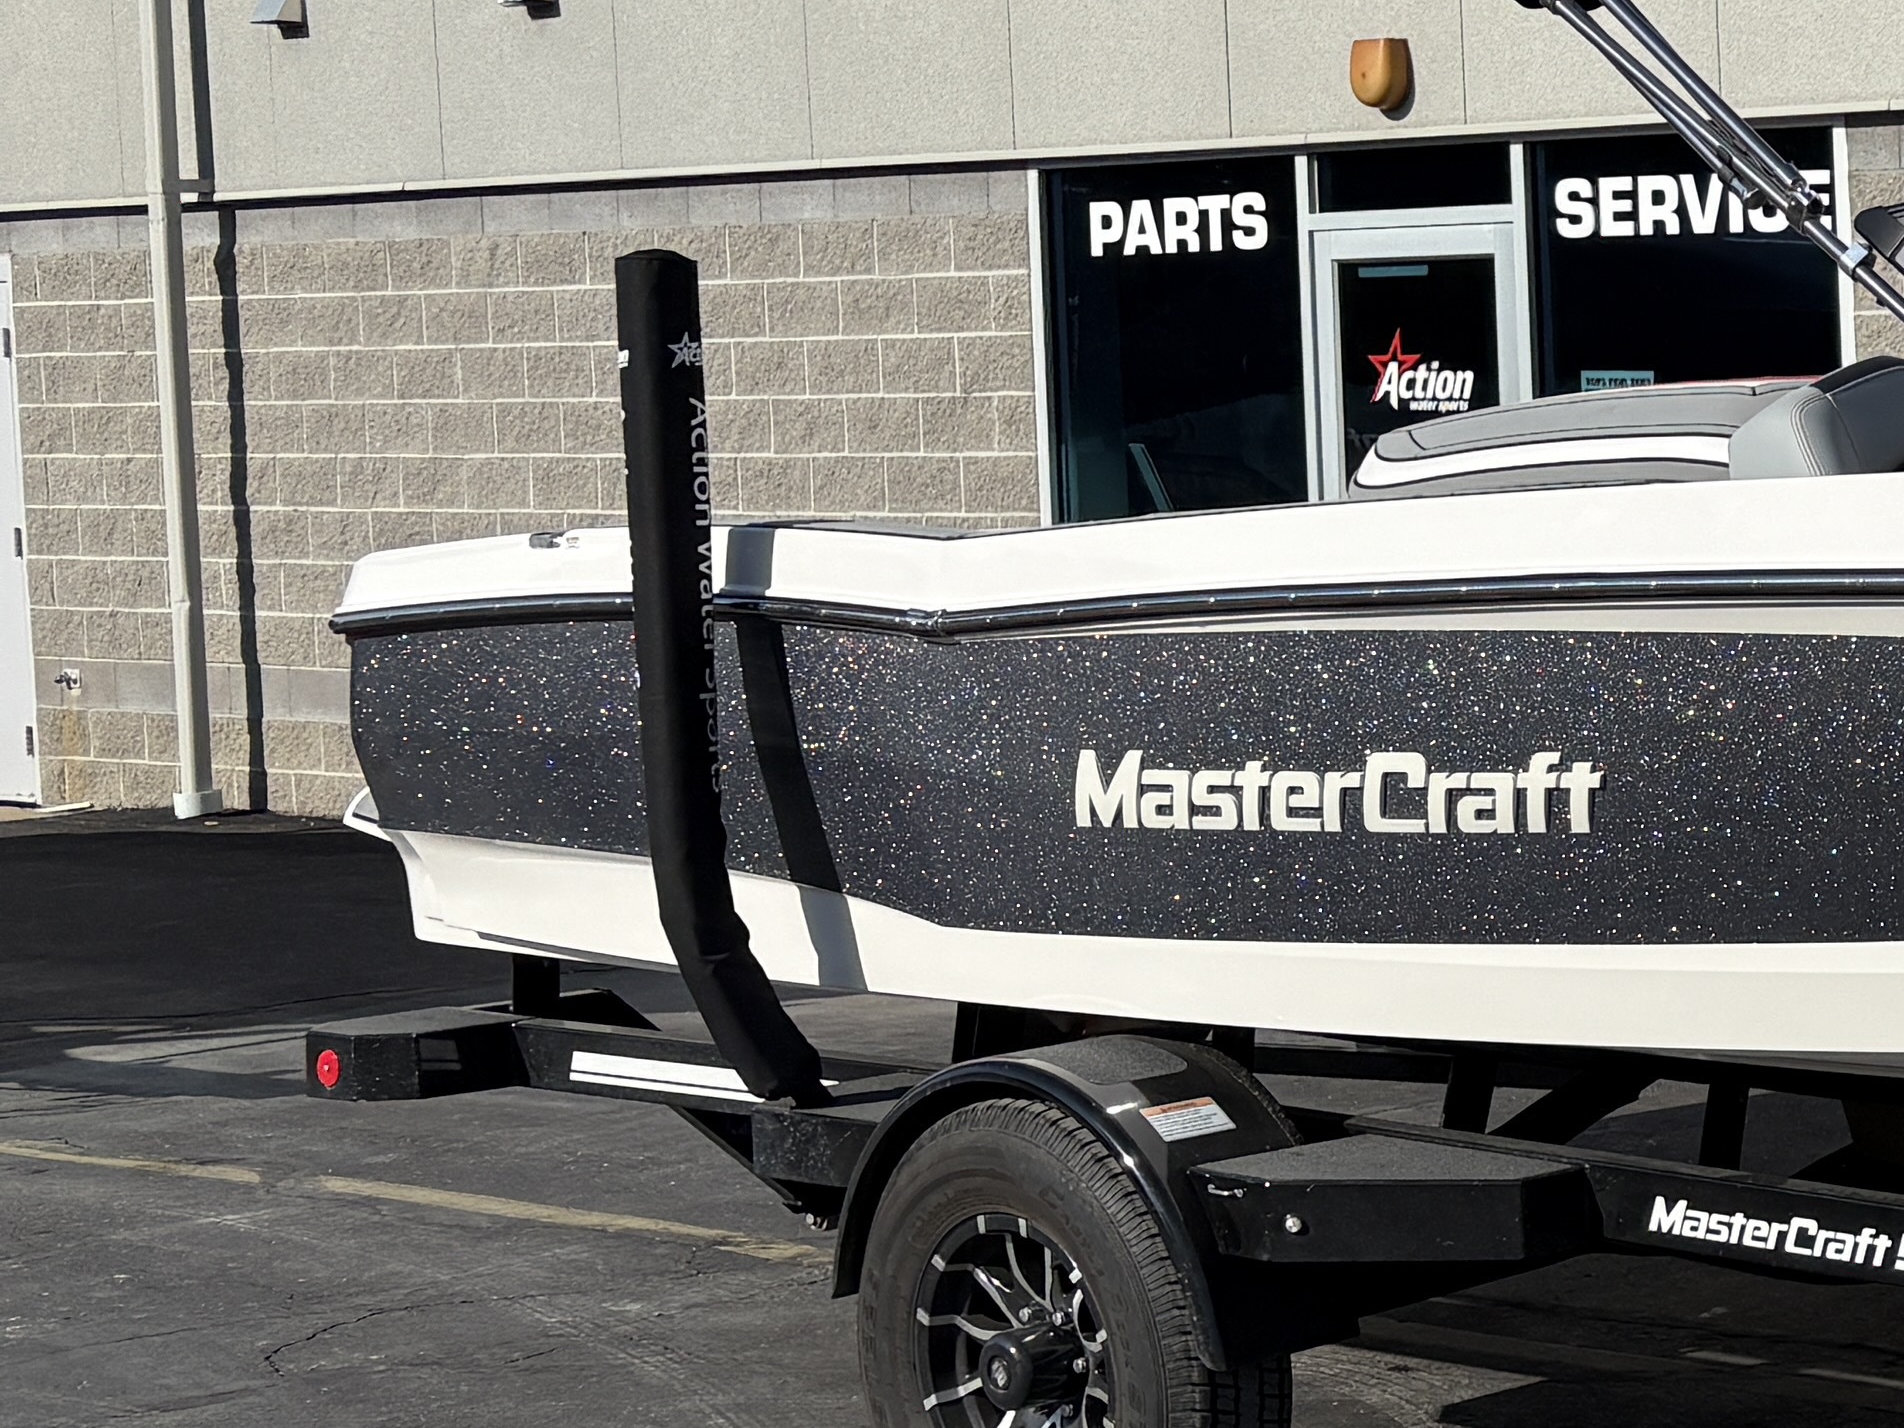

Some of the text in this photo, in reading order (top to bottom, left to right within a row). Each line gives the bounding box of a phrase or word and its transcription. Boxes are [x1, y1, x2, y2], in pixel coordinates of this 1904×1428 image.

[1088, 191, 1269, 258] PARTS
[1374, 360, 1475, 411] Action
[1074, 749, 1605, 834] MasterCraft
[1649, 1196, 1892, 1267] MasterCraft
